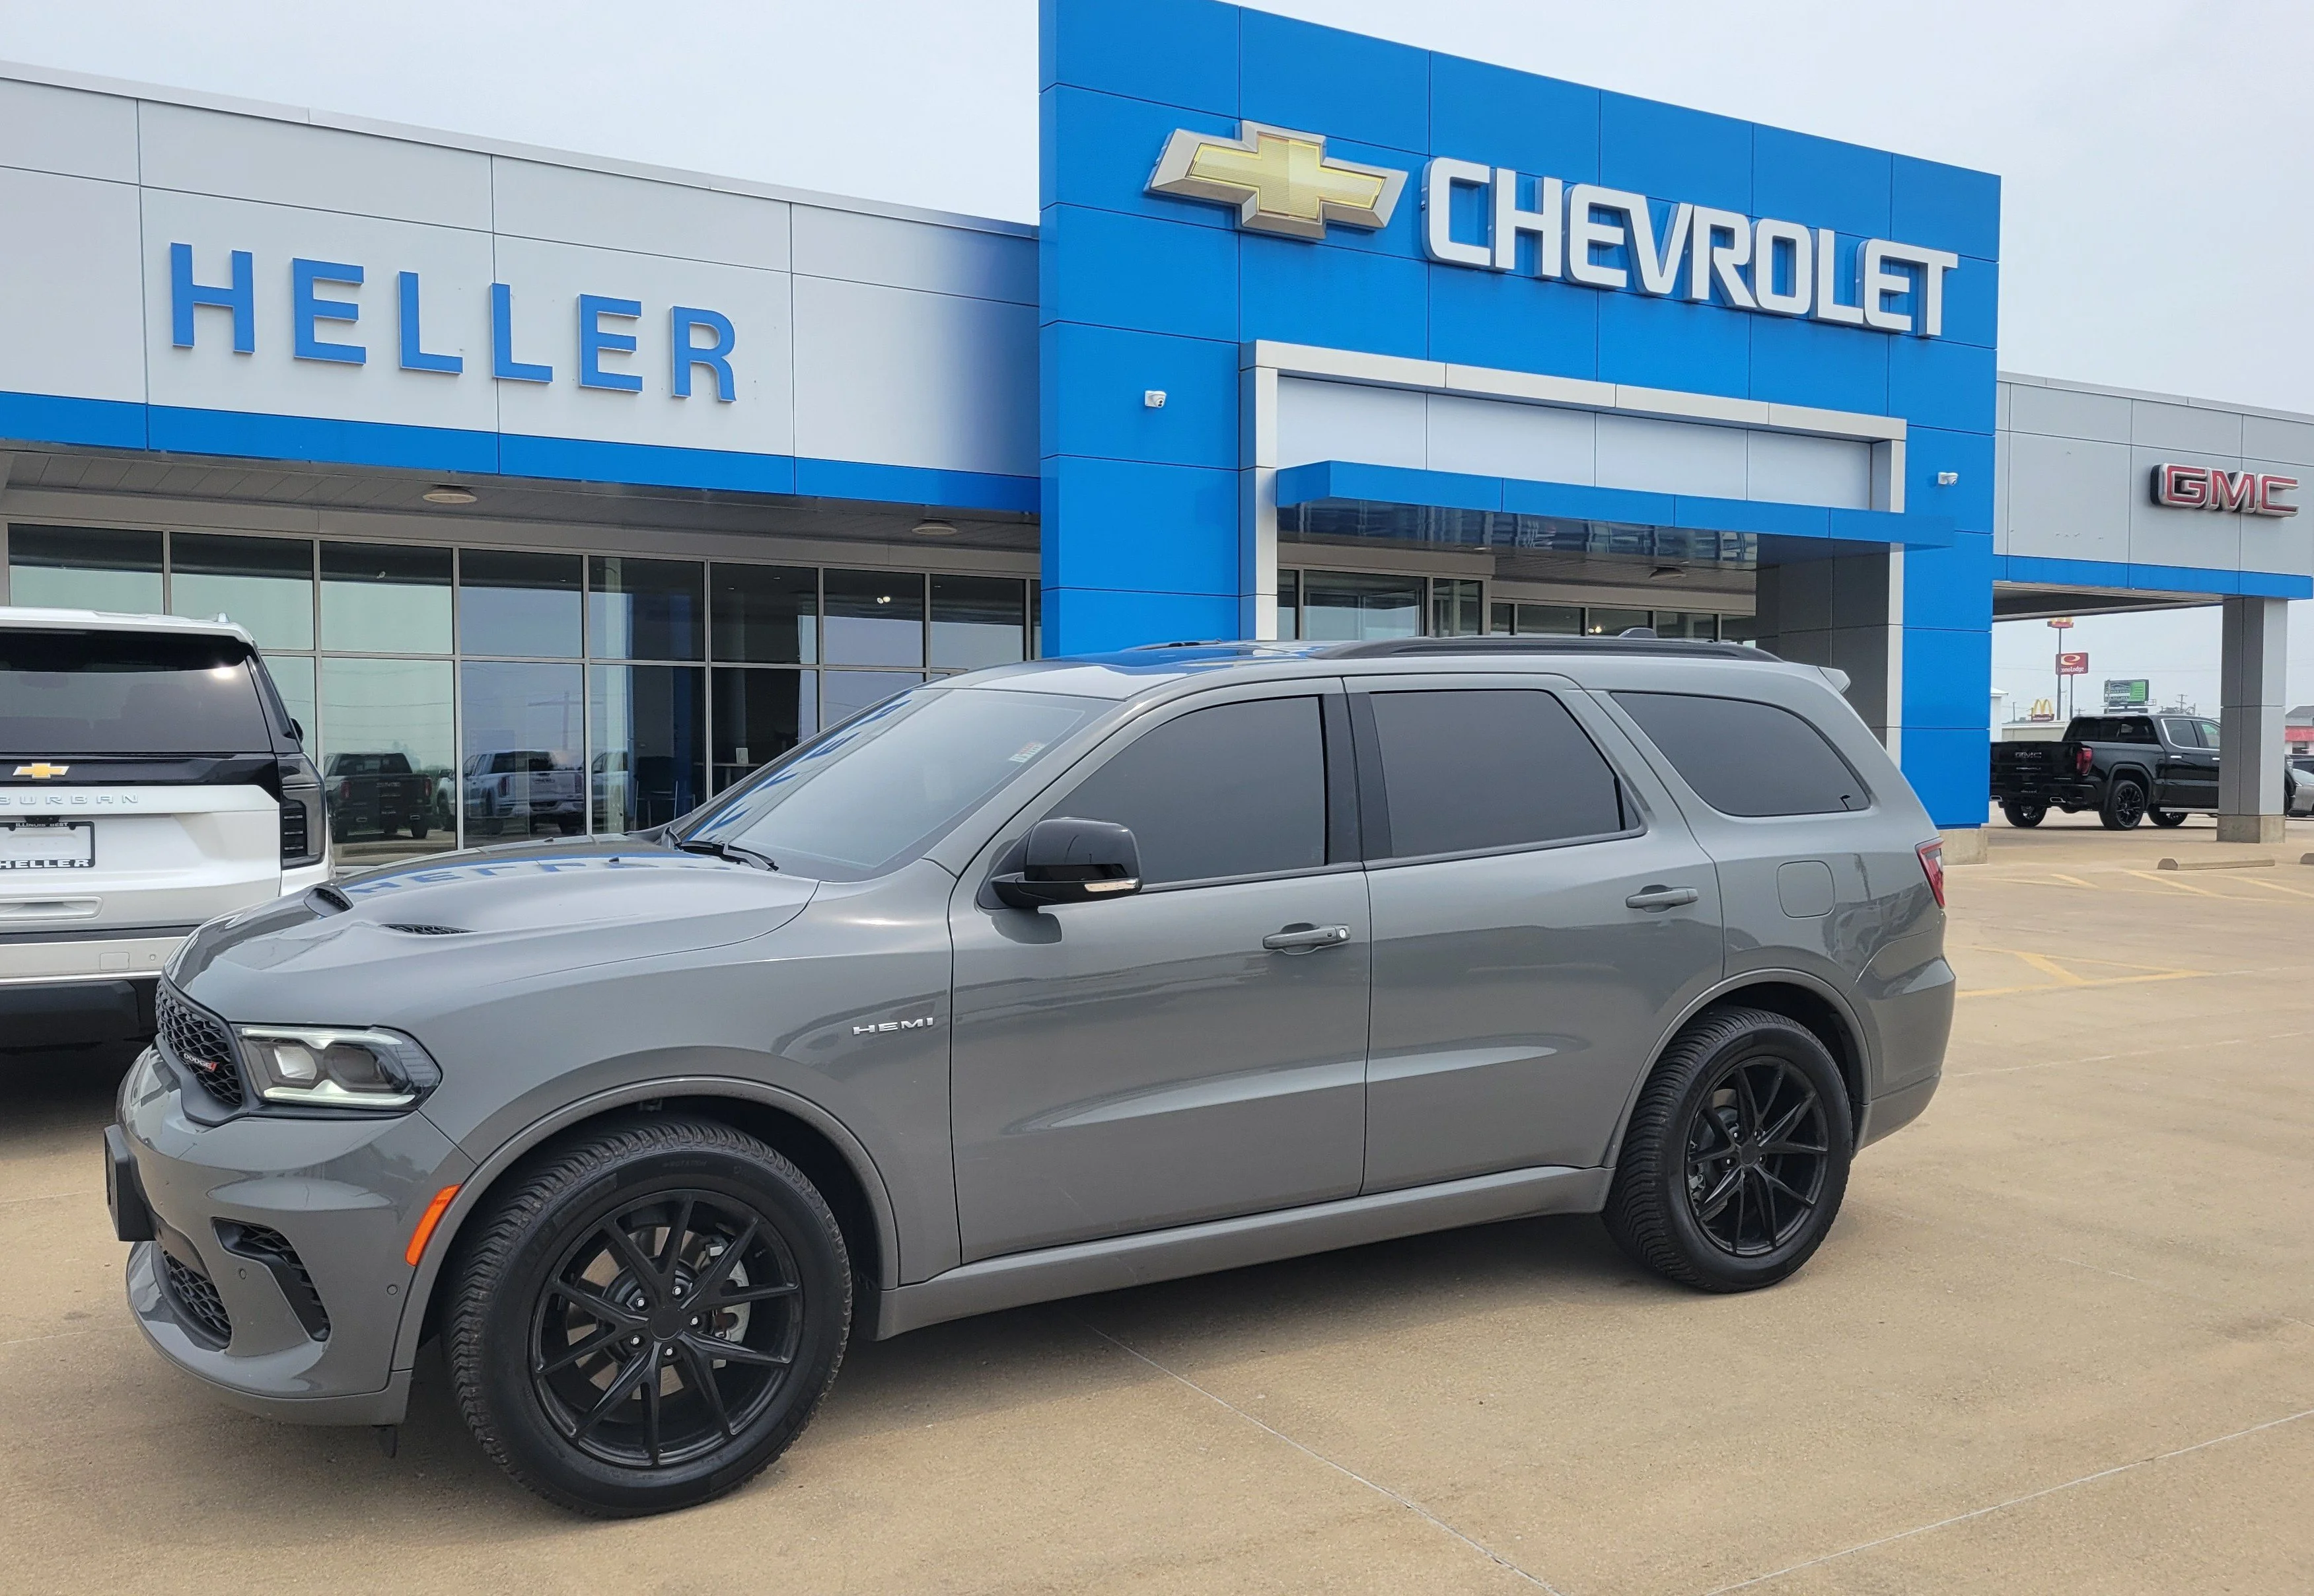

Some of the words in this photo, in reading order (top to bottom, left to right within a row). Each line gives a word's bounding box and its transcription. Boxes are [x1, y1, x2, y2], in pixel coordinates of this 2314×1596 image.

[1422, 157, 1959, 338] CHEVROLET
[170, 242, 736, 402] HELLER
[2150, 462, 2299, 518] GMC
[0, 859, 89, 869] HELLER
[853, 1017, 933, 1035] HEMI
[183, 1052, 213, 1070] DODGE
